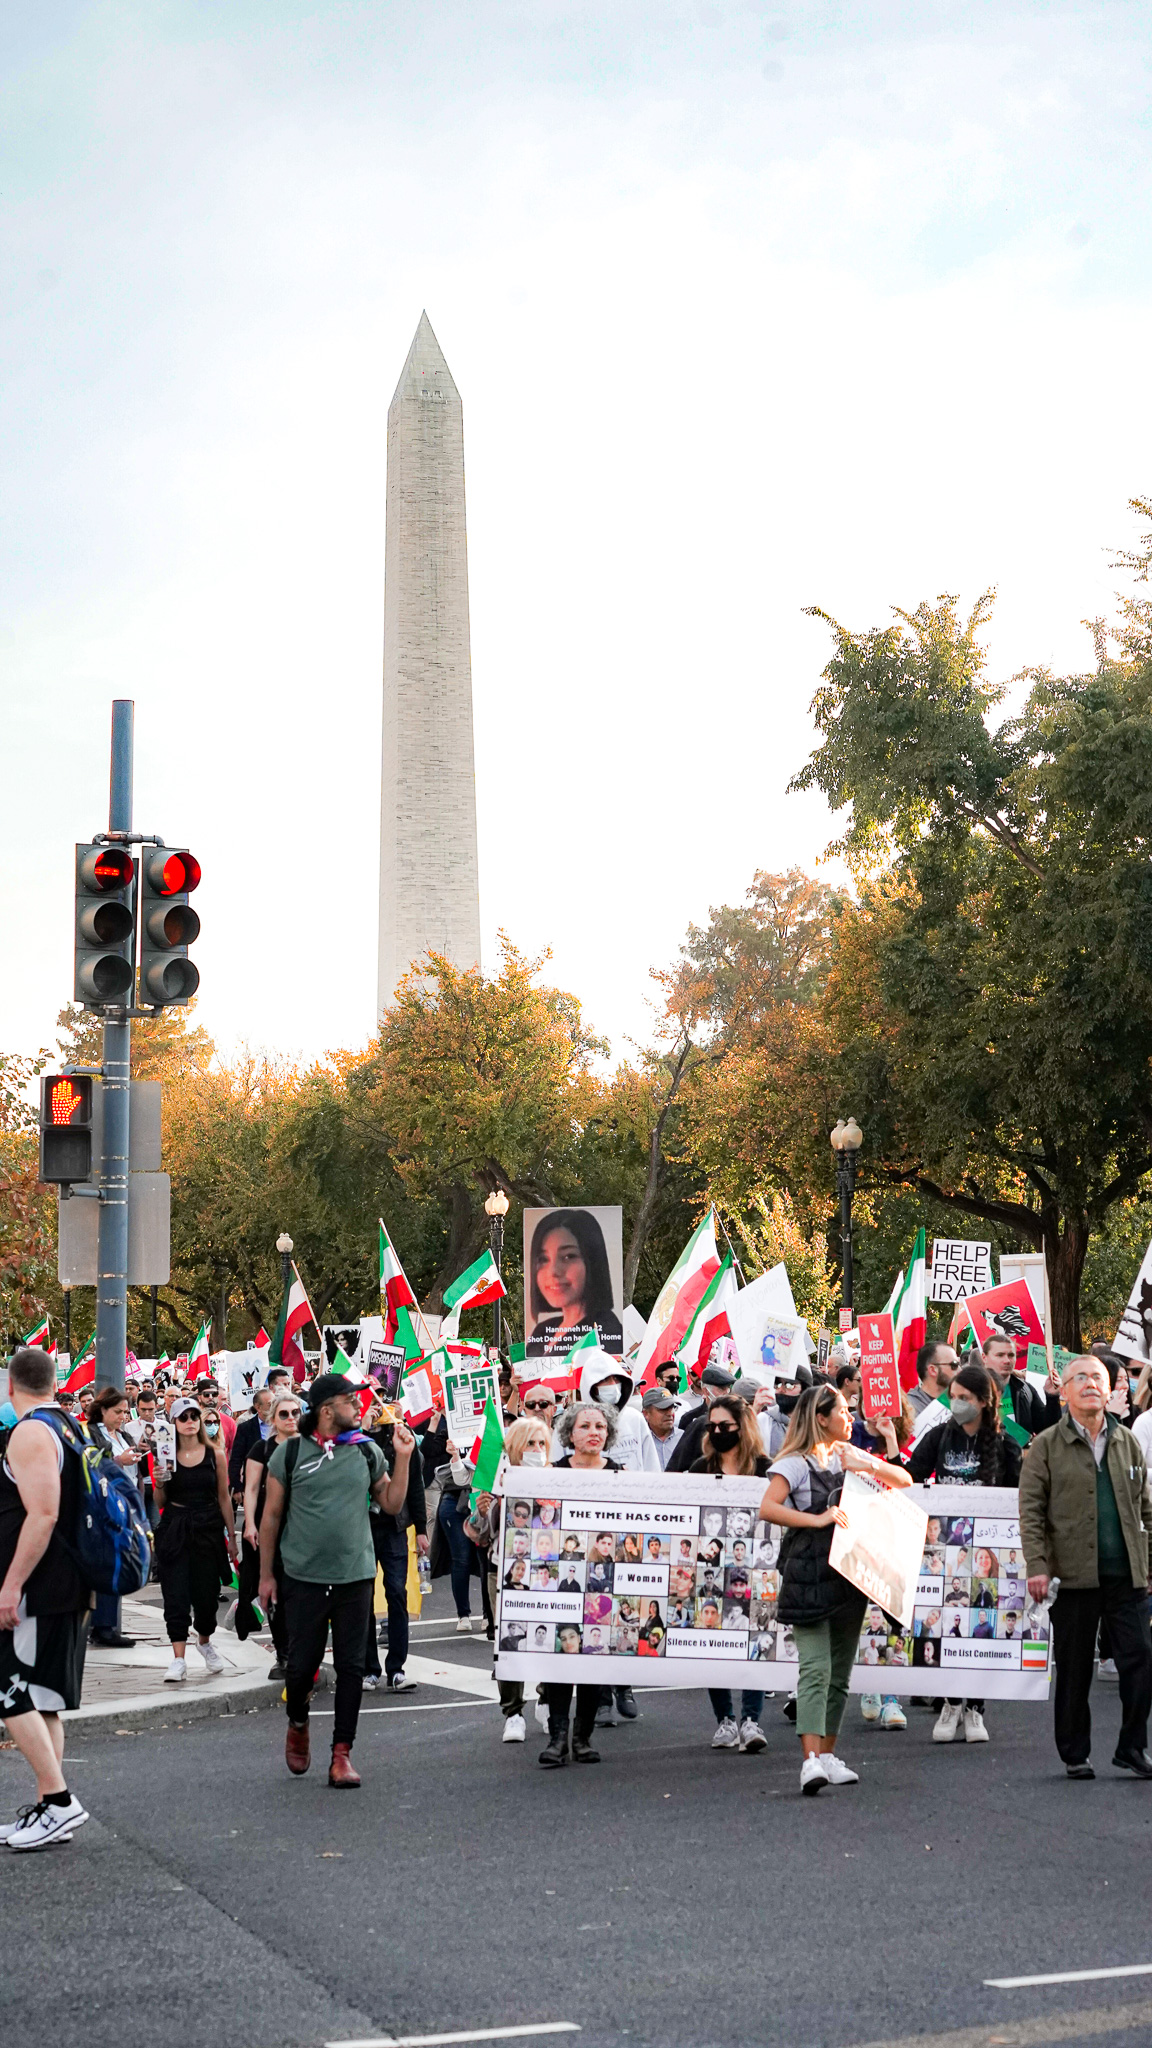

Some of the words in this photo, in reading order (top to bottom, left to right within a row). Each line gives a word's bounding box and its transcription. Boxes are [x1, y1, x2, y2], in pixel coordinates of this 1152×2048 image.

[935, 1243, 989, 1262] HELP
[934, 1263, 987, 1283] FREE
[545, 1325, 581, 1333] Hannaneh
[527, 1335, 544, 1343] Shot
[544, 1344, 552, 1352] By
[554, 1344, 574, 1352] Irania
[868, 1340, 884, 1351] KEEP
[371, 1350, 402, 1365] WOMAN
[862, 1353, 893, 1365] FIGHTING
[1054, 1352, 1072, 1361] Revol
[1033, 1364, 1045, 1372] IS
[870, 1393, 893, 1408] NIAC
[569, 1510, 592, 1519] THE
[595, 1511, 622, 1520] TIME
[626, 1512, 650, 1522] HAS
[654, 1514, 686, 1523] COME
[976, 1524, 998, 1538] آزادی
[627, 1573, 663, 1583] Woman
[916, 1585, 940, 1593] edom
[504, 1600, 536, 1609] Children
[550, 1602, 577, 1611] Victims
[667, 1638, 698, 1647] Silence
[699, 1639, 707, 1647] is
[708, 1640, 747, 1648] Violence!
[944, 1648, 957, 1657] The
[958, 1649, 972, 1657] List
[973, 1650, 1012, 1659] Continues
